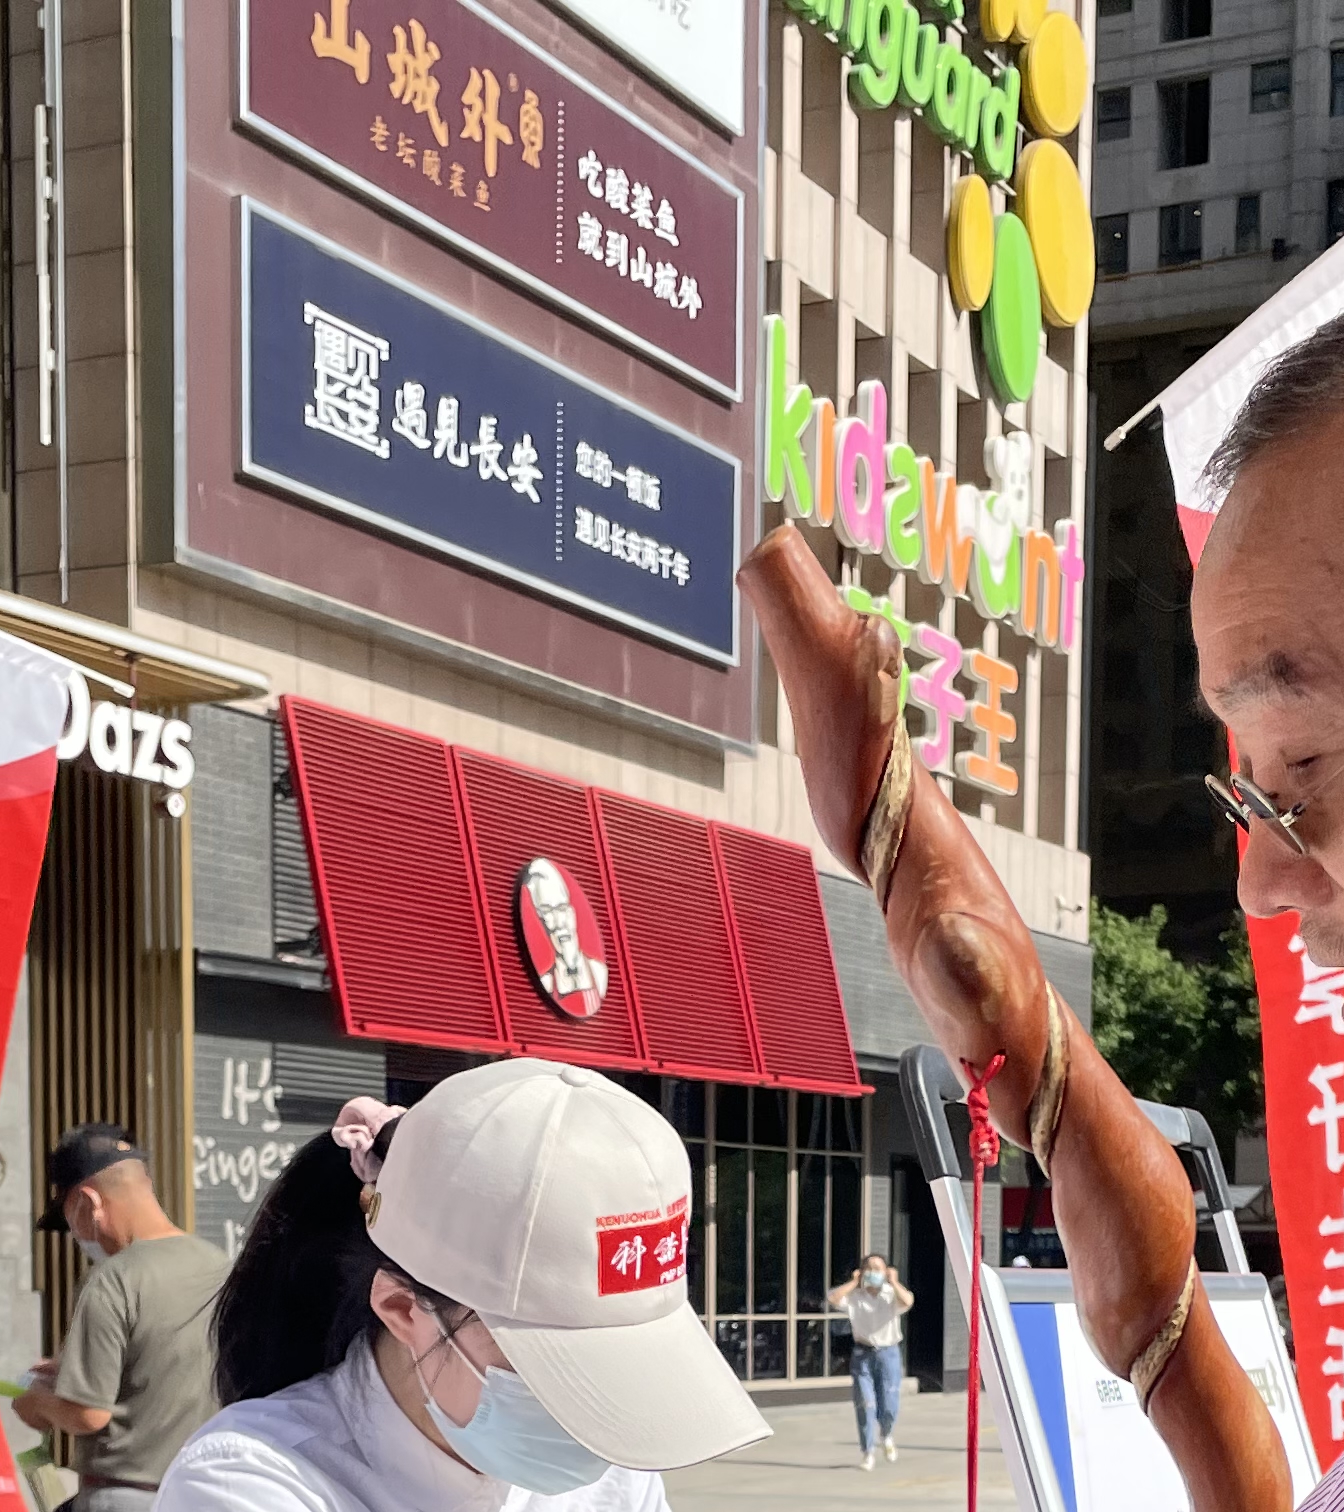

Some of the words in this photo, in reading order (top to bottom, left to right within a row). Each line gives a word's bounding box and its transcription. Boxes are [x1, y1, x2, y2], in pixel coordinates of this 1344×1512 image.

[369, 115, 491, 212] 老坛酸菜鱼
[577, 149, 681, 247] 吃酸菜鱼
[574, 506, 691, 586] 遇见长安两千年
